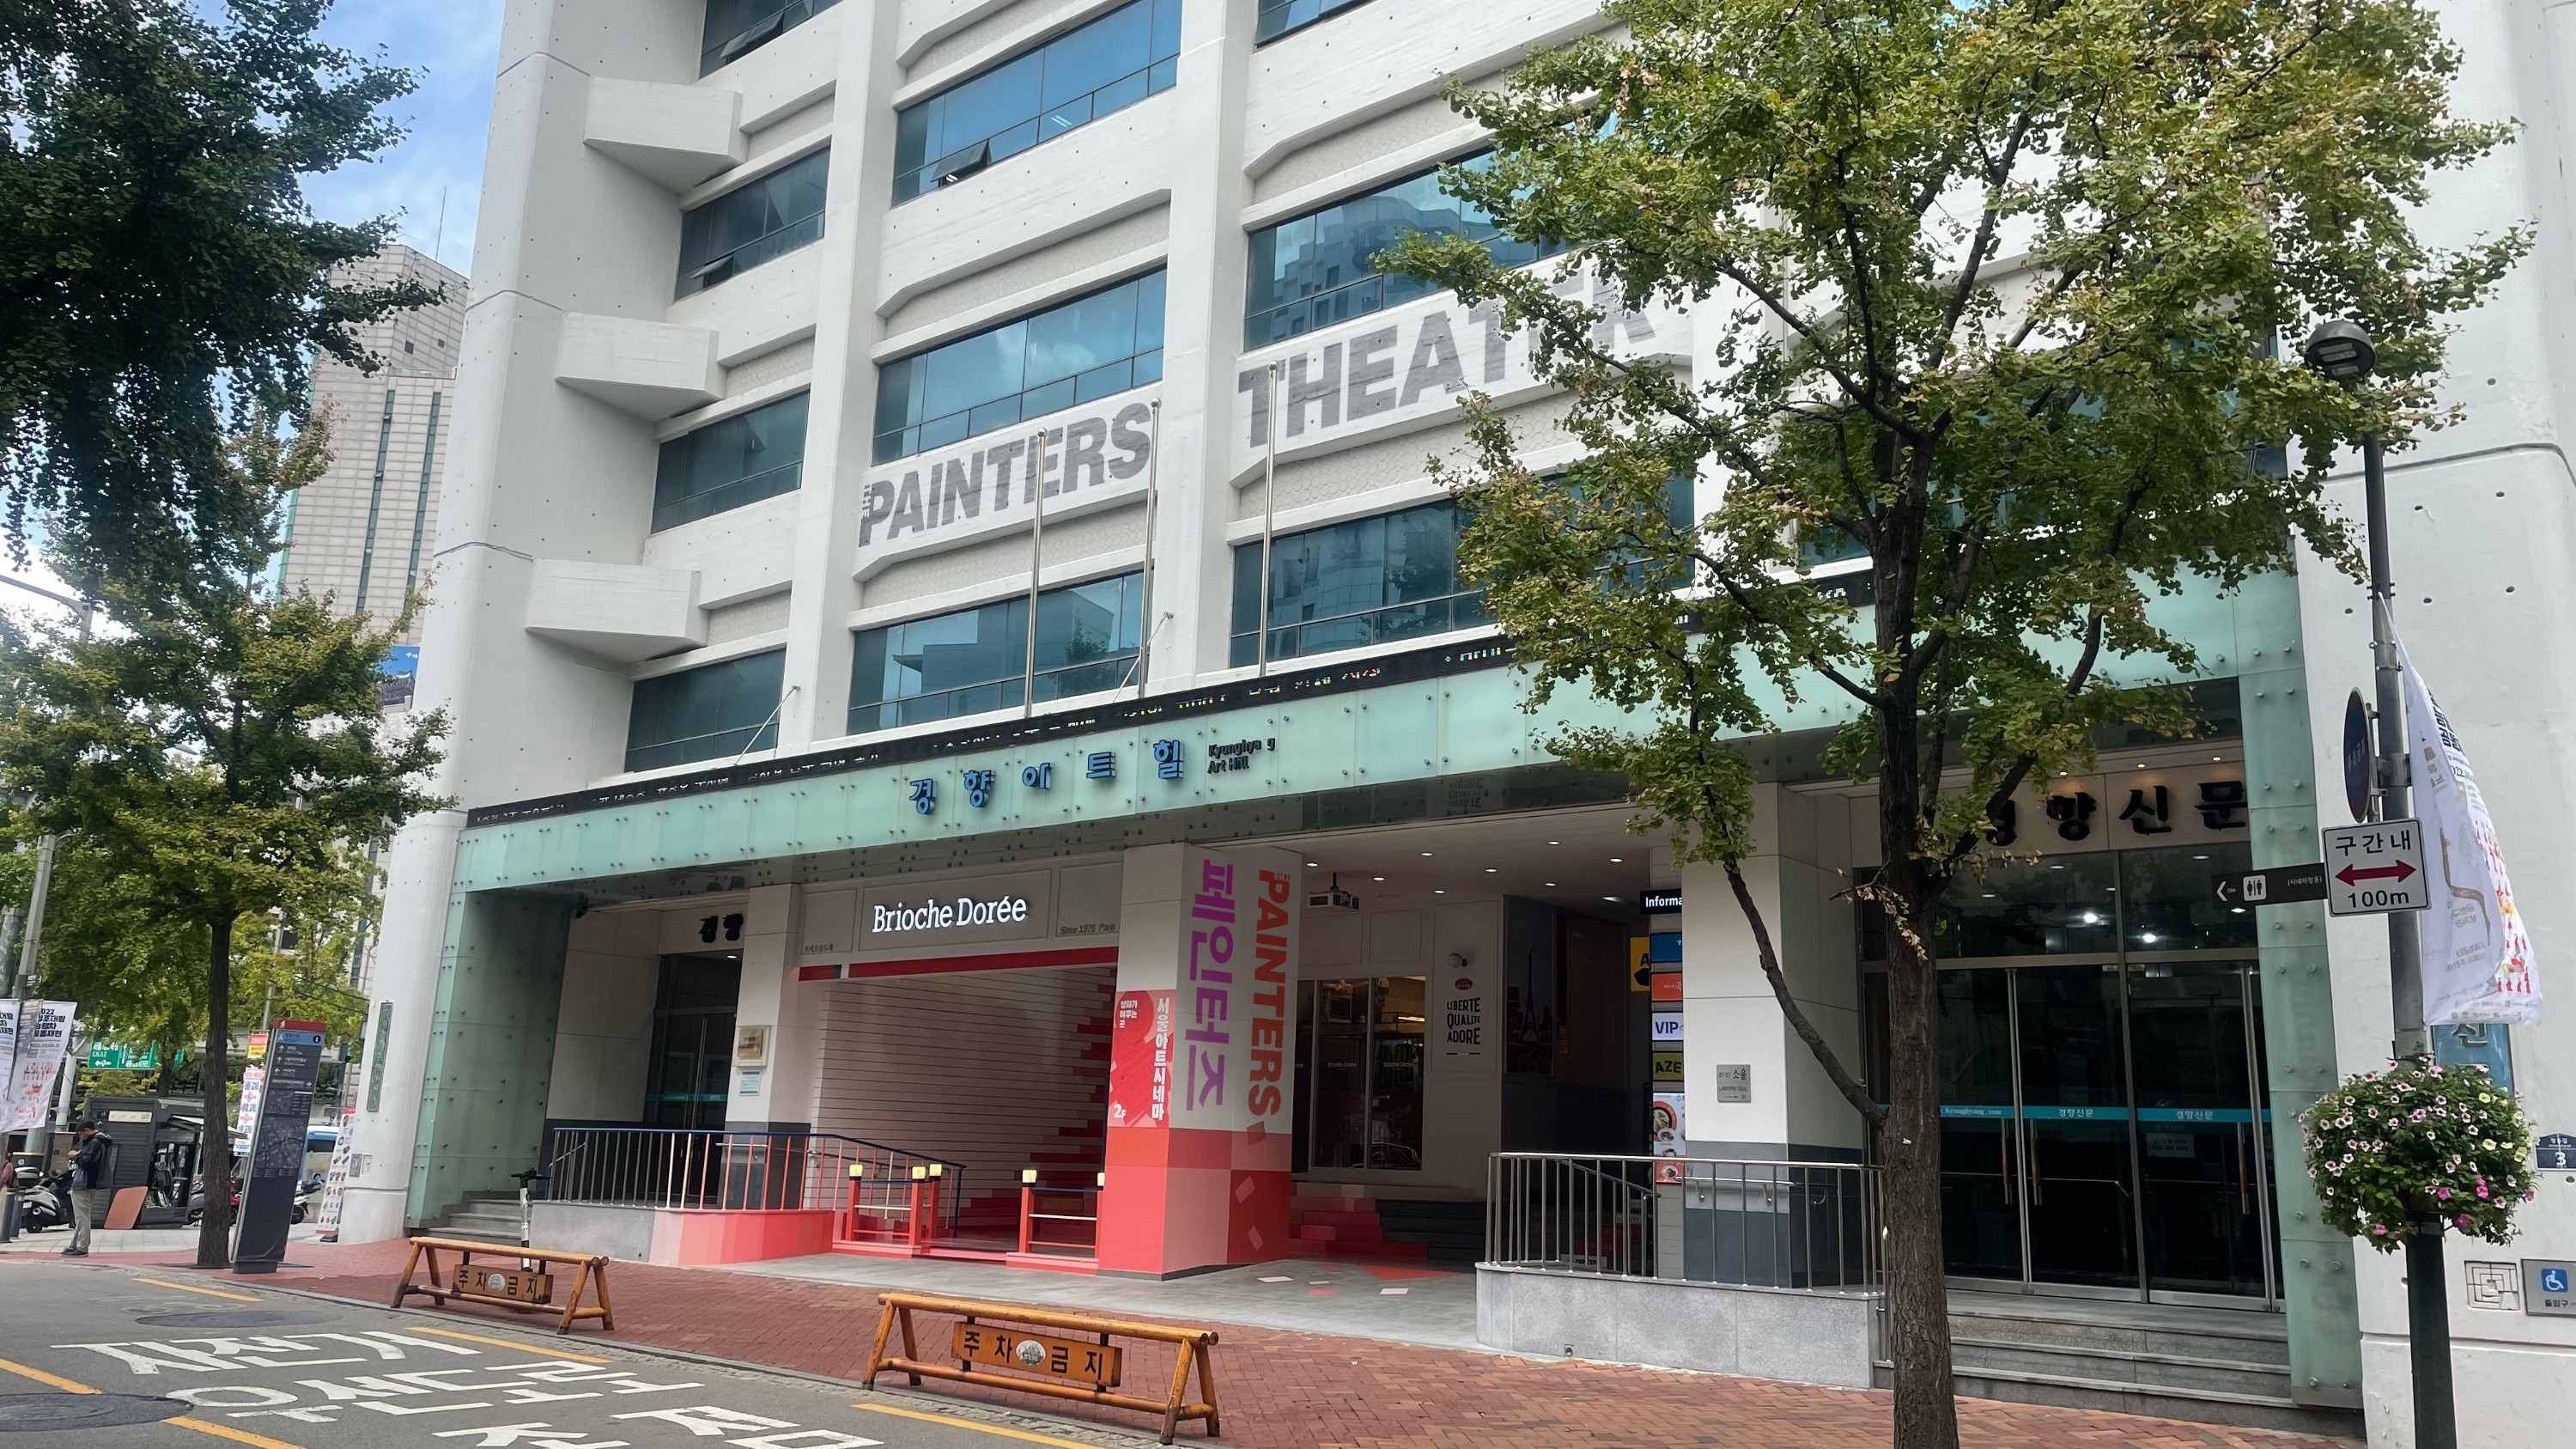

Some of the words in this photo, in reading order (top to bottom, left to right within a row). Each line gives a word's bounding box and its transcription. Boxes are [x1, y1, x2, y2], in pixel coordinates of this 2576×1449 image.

[859, 402, 1152, 548] PAINTERS
[1207, 760, 1227, 774] Art
[1228, 756, 1250, 771] Hill
[2348, 890, 2410, 909] 100m
[872, 898, 954, 934] Brioche
[956, 895, 1030, 927] Dorée
[1060, 926, 1078, 935] Since
[1099, 922, 1116, 932] Paris
[1185, 858, 1236, 1111] 페인터즈
[1248, 868, 1291, 1117] PAINTERS
[1446, 997, 1481, 1013] LIBERTE
[1446, 1013, 1481, 1030] QUALITE
[1655, 1020, 1680, 1034] VIP
[1446, 1027, 1481, 1045] ADORE
[1151, 997, 1170, 1121] 서울아트시네마
[1114, 1104, 1127, 1119] 2F
[2057, 1108, 2095, 1118] 경향신문
[2174, 1109, 2215, 1120] 경향신문
[2555, 1151, 2567, 1166] 3
[458, 1269, 538, 1300] 주차금지
[49, 1330, 483, 1375] 자전거
[963, 1330, 1104, 1380] 주차금지
[165, 1361, 705, 1422] 우선도로
